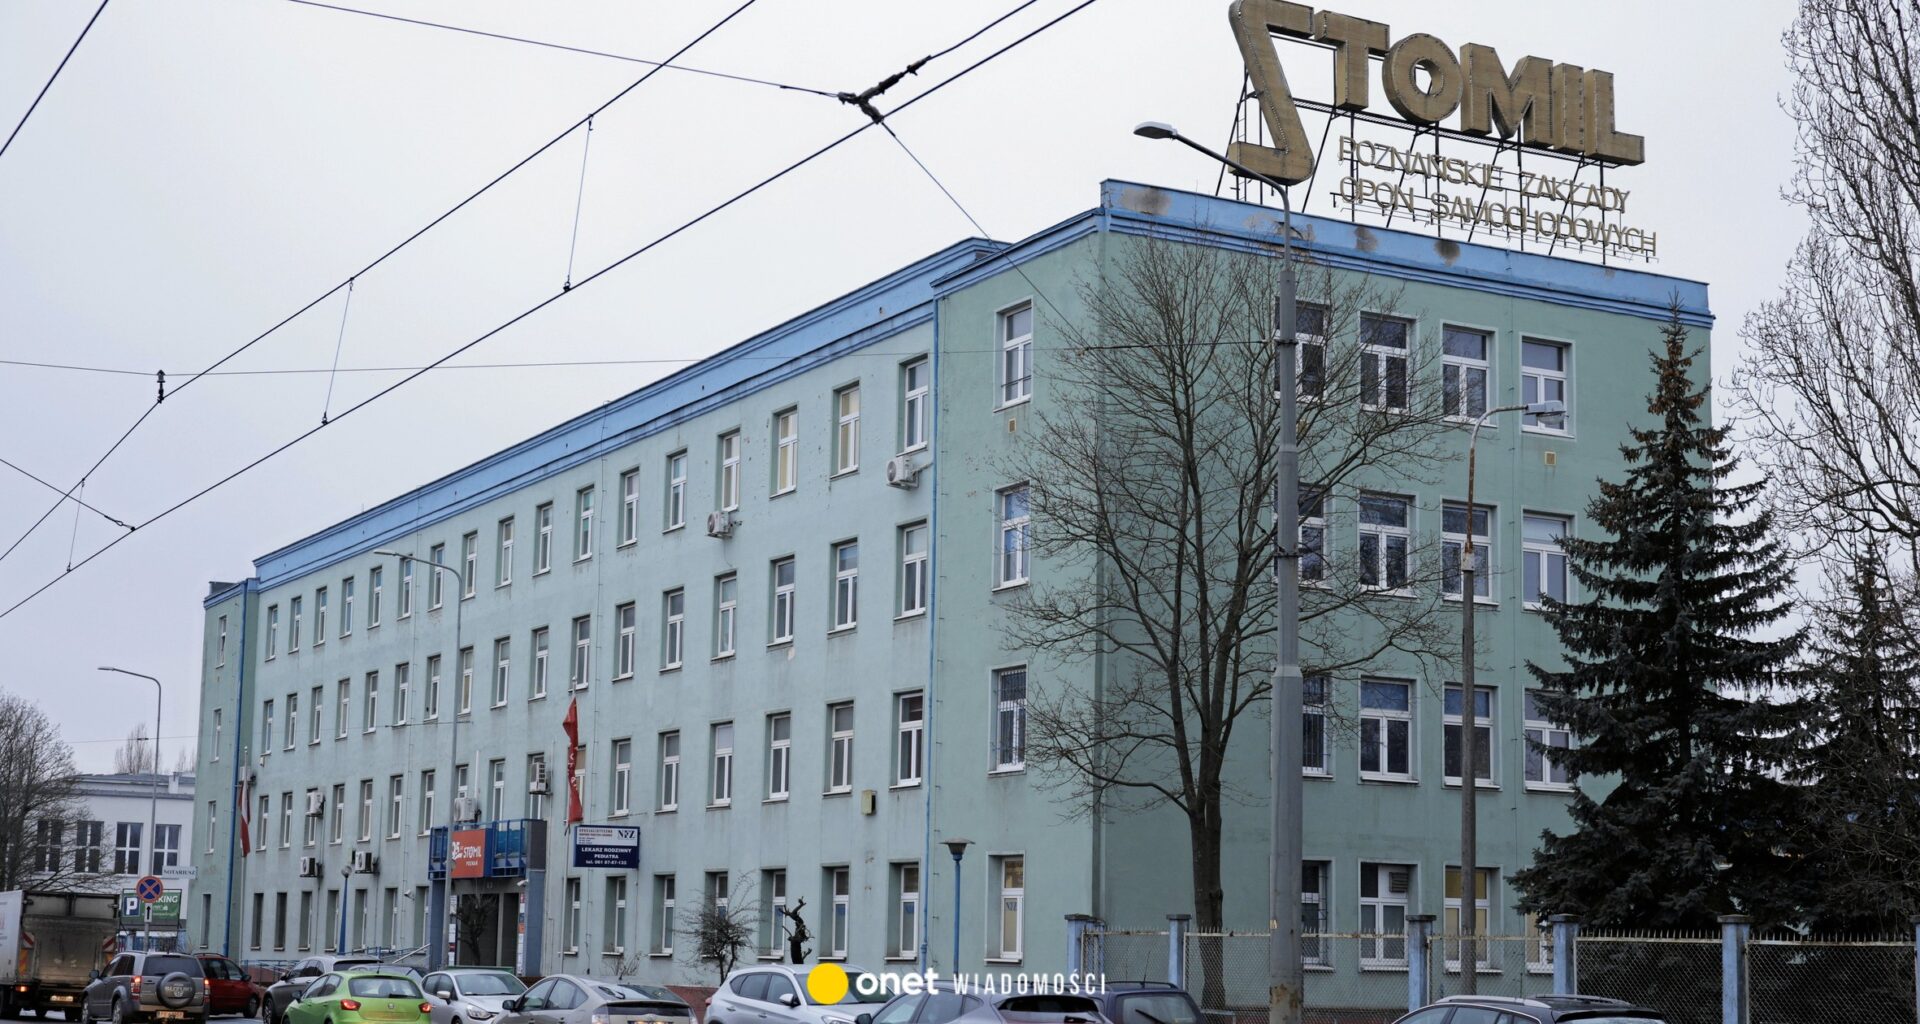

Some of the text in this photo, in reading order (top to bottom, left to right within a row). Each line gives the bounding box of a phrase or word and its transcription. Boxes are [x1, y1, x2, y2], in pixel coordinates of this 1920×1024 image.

[1229, 0, 1645, 186] STOMIL
[1338, 135, 1630, 214] POZNAŃSKIE ZAKŁADY
[1340, 176, 1657, 257] OPON SAMOCHODOWYCH
